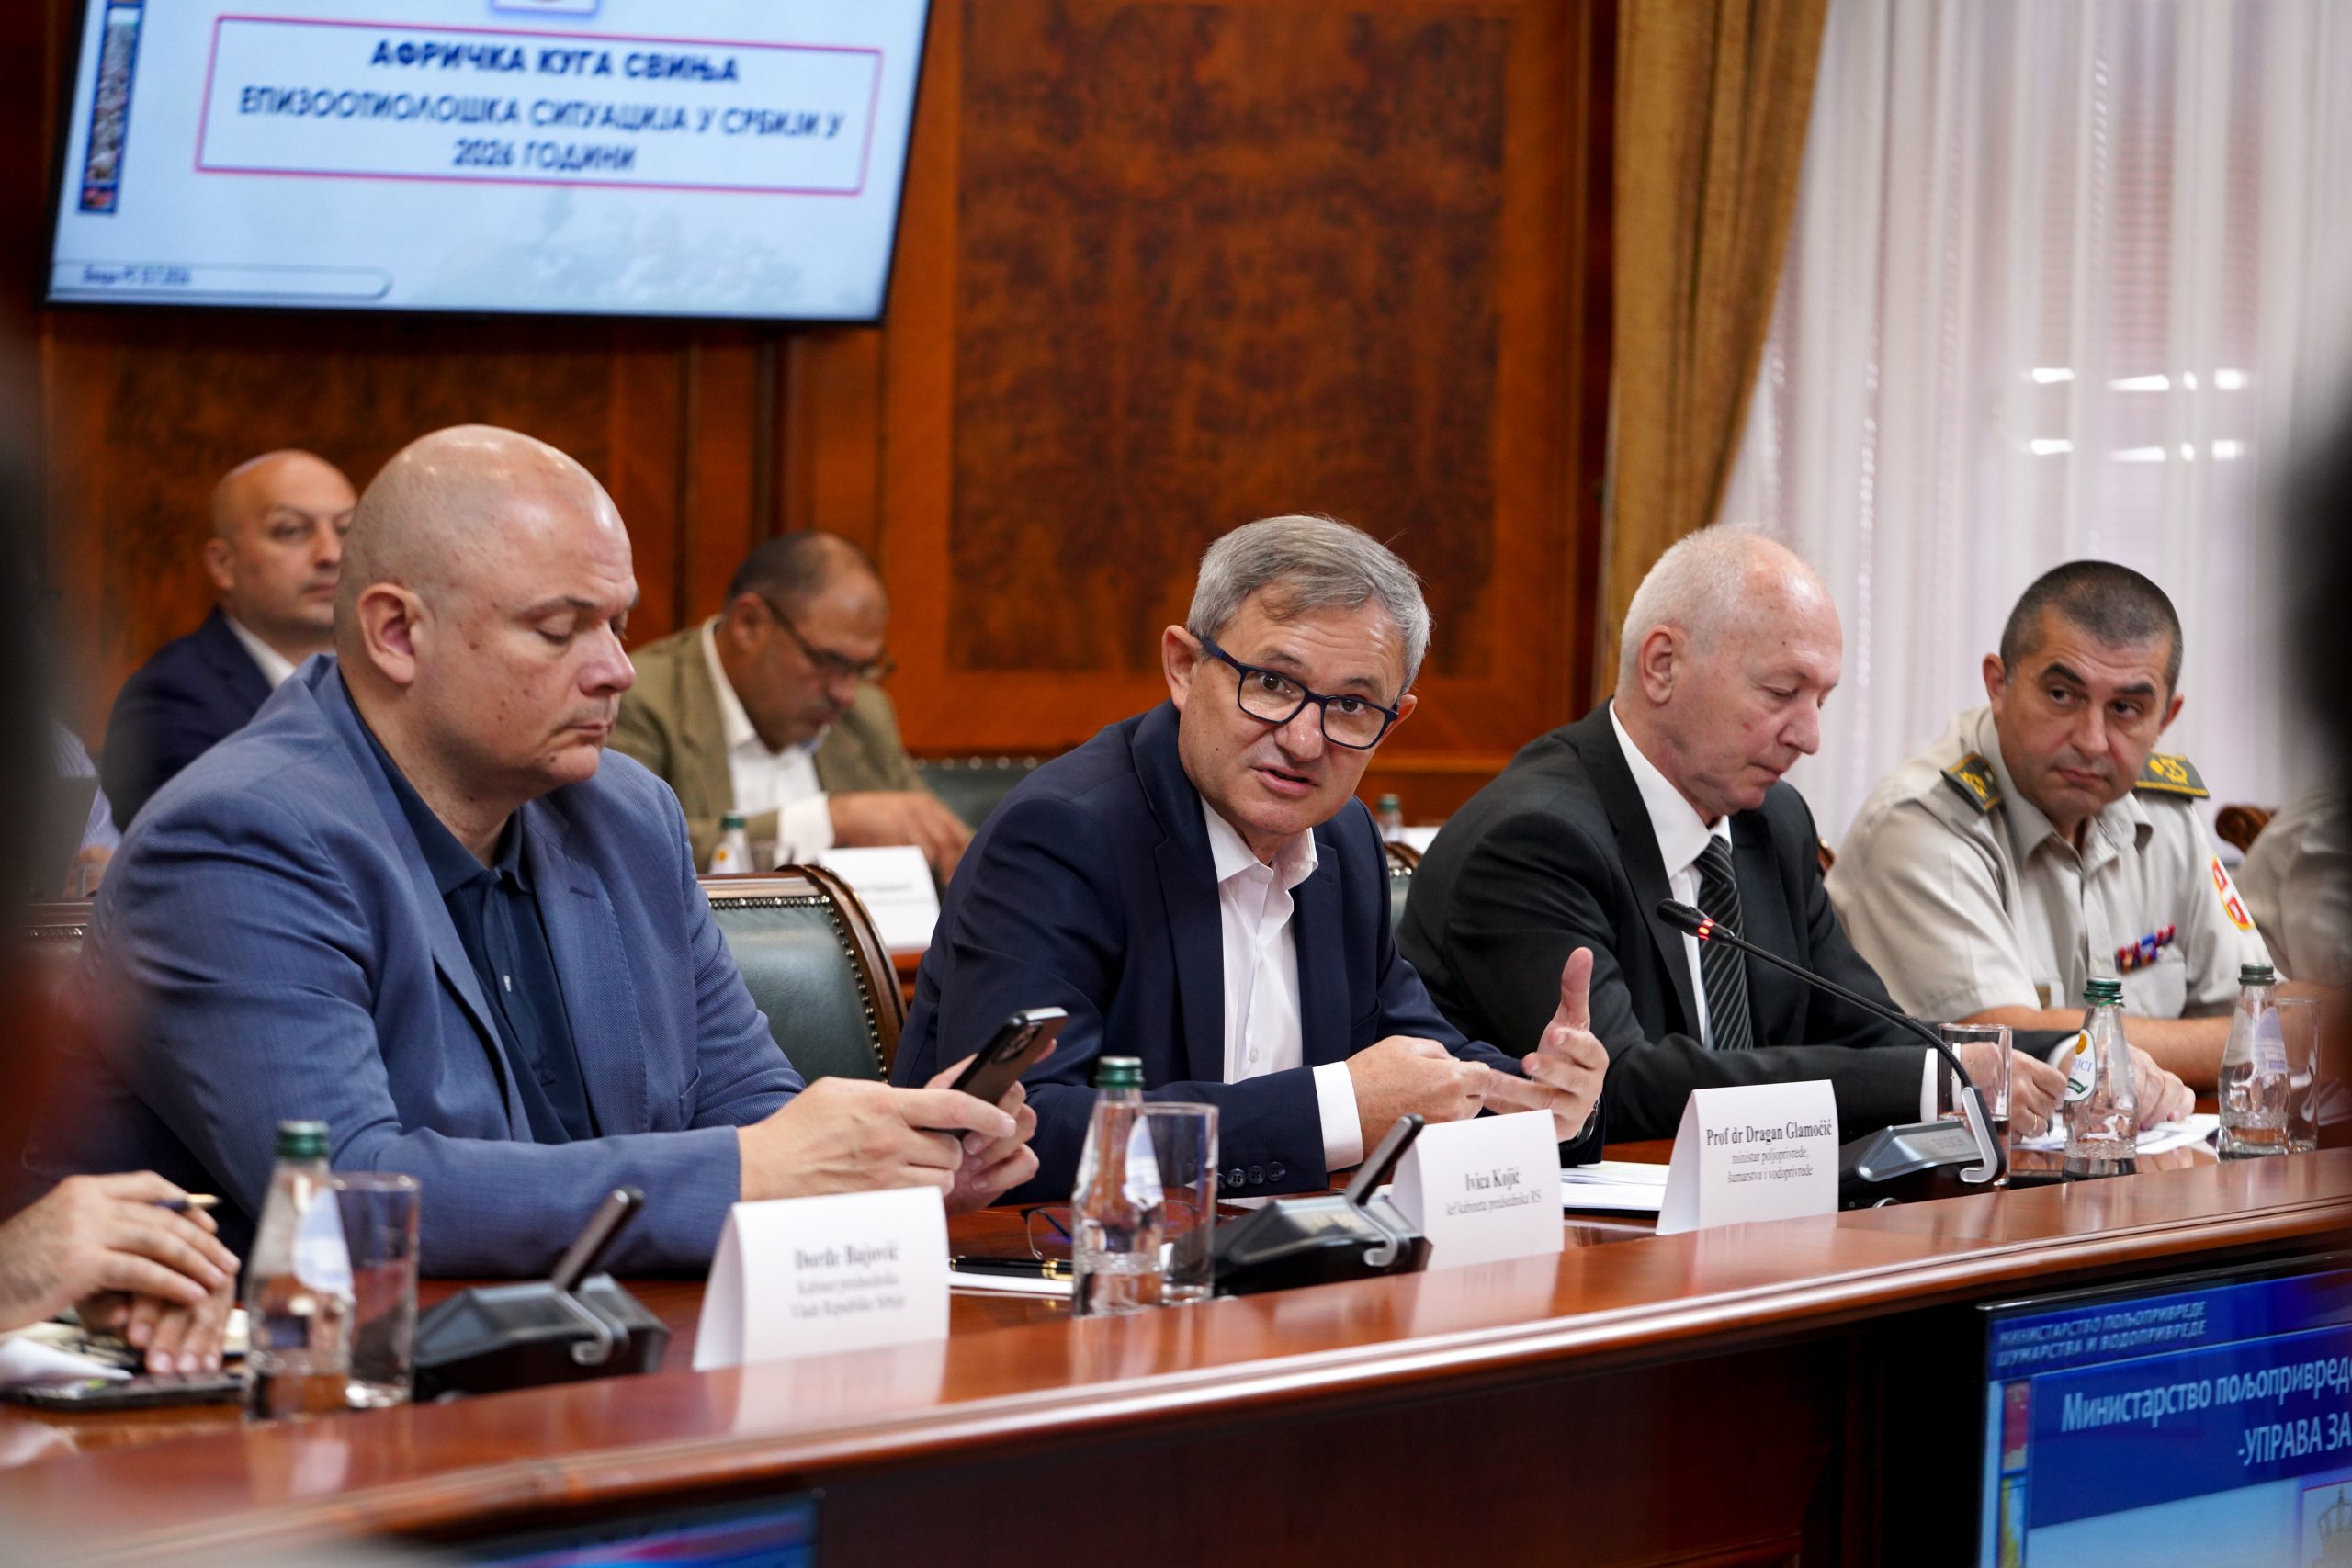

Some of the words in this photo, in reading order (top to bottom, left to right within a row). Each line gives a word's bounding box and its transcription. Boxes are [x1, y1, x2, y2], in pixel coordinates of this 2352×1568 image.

[370, 39, 526, 72] АФРИЧКА
[536, 49, 613, 75] КУГА
[624, 52, 740, 81] СВИЊА
[239, 85, 521, 124] ЕПИЗООТИОЛОШКА
[528, 99, 688, 131] СИТУАЦИЈА
[695, 107, 716, 133] У
[719, 107, 821, 137] СРБИЈИ
[826, 111, 845, 139] У
[452, 138, 514, 166] 2026
[523, 141, 637, 171] ГОДИНИ
[1706, 1128, 1729, 1146] Prof
[1731, 1127, 1743, 1144] dr
[1746, 1126, 1783, 1145] Dragan
[1786, 1119, 1833, 1140] Glamočić
[1732, 1150, 1760, 1164] ministar
[1464, 1172, 1490, 1191] Ivica
[1996, 1338, 2083, 1367] ШУМАРСТВА
[2086, 1337, 2098, 1352] И
[2099, 1319, 2208, 1350] ВОДОПРИВРЕДЕ
[1997, 1316, 2102, 1347] МИНИСТАРСТВО
[2102, 1301, 2207, 1331] ПОЉОПРИВРЕДЕ
[2061, 1379, 2211, 1432] Министарство
[2215, 1355, 2352, 1406] пољопривред
[2237, 1416, 2323, 1466] -УПРАВА
